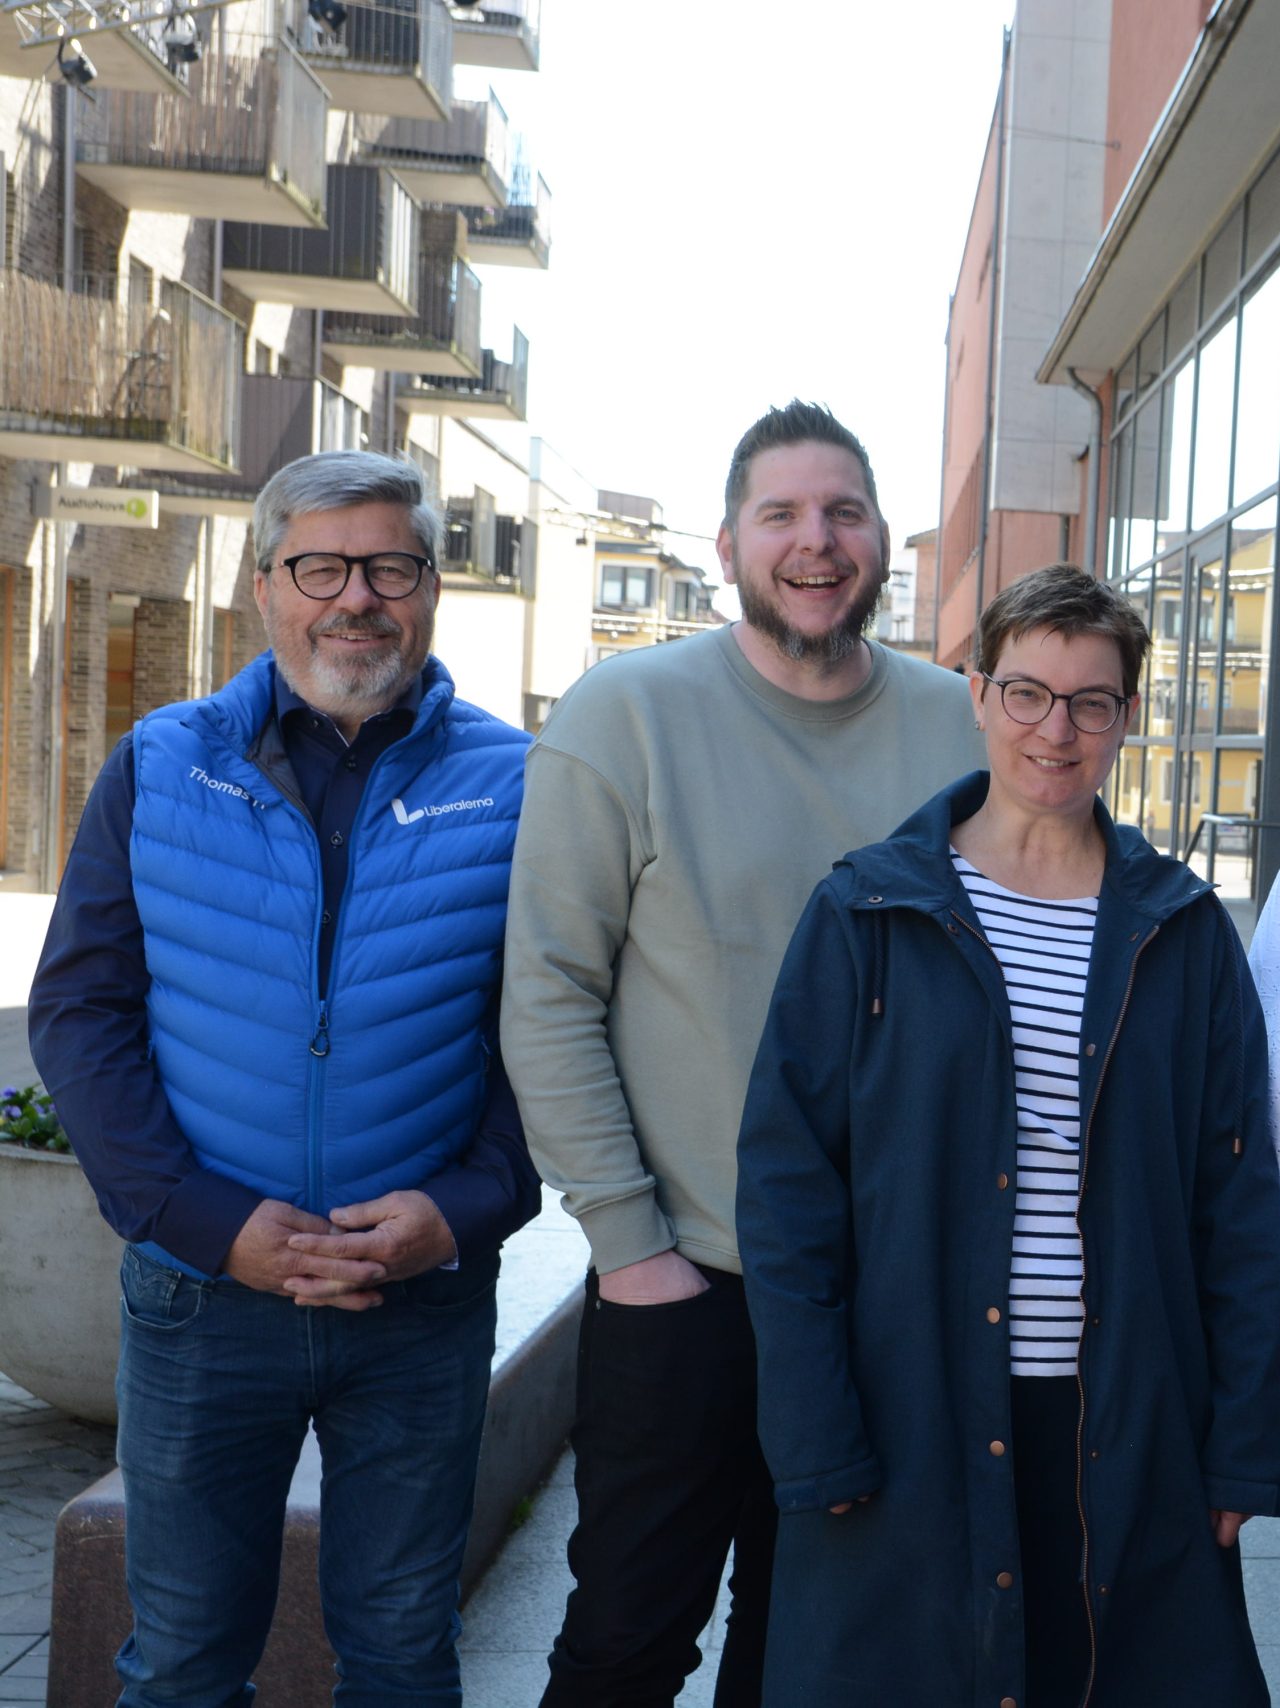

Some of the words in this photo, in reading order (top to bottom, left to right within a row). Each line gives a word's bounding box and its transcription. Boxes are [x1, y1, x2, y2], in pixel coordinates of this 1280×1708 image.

[58, 495, 125, 511] AudioNova
[189, 766, 250, 800] Thomas
[424, 797, 494, 817] Liberalerna
